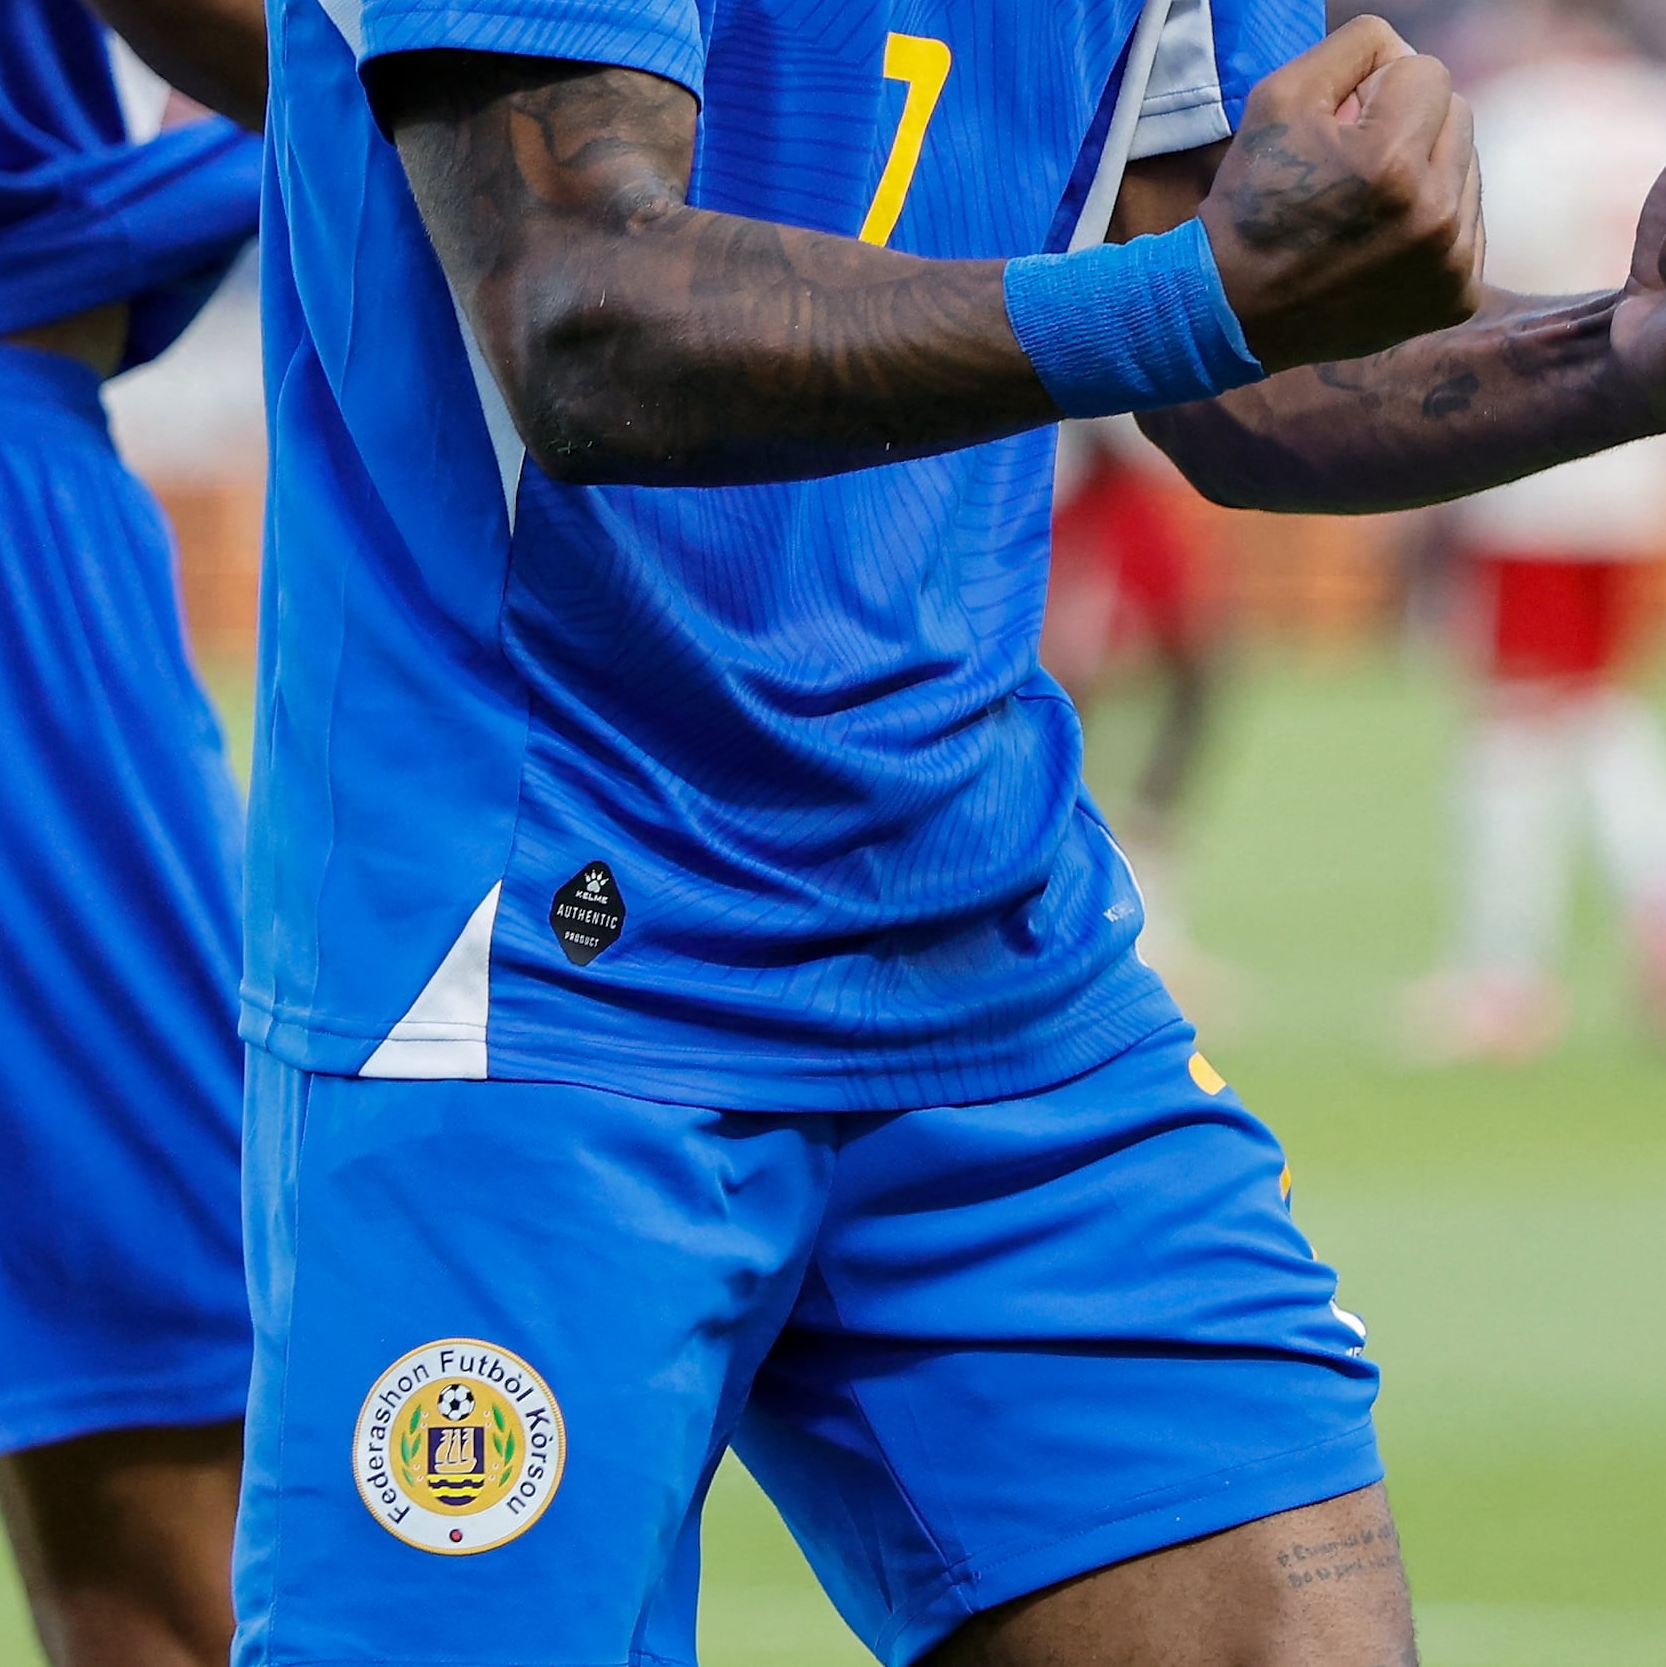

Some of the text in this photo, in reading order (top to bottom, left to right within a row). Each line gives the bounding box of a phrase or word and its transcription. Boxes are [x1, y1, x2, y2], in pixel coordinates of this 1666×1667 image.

[858, 32, 952, 247] 7
[557, 903, 618, 929] AUTHENTIC
[564, 931, 600, 947] PRODUCT
[367, 1363, 430, 1524] Federashon
